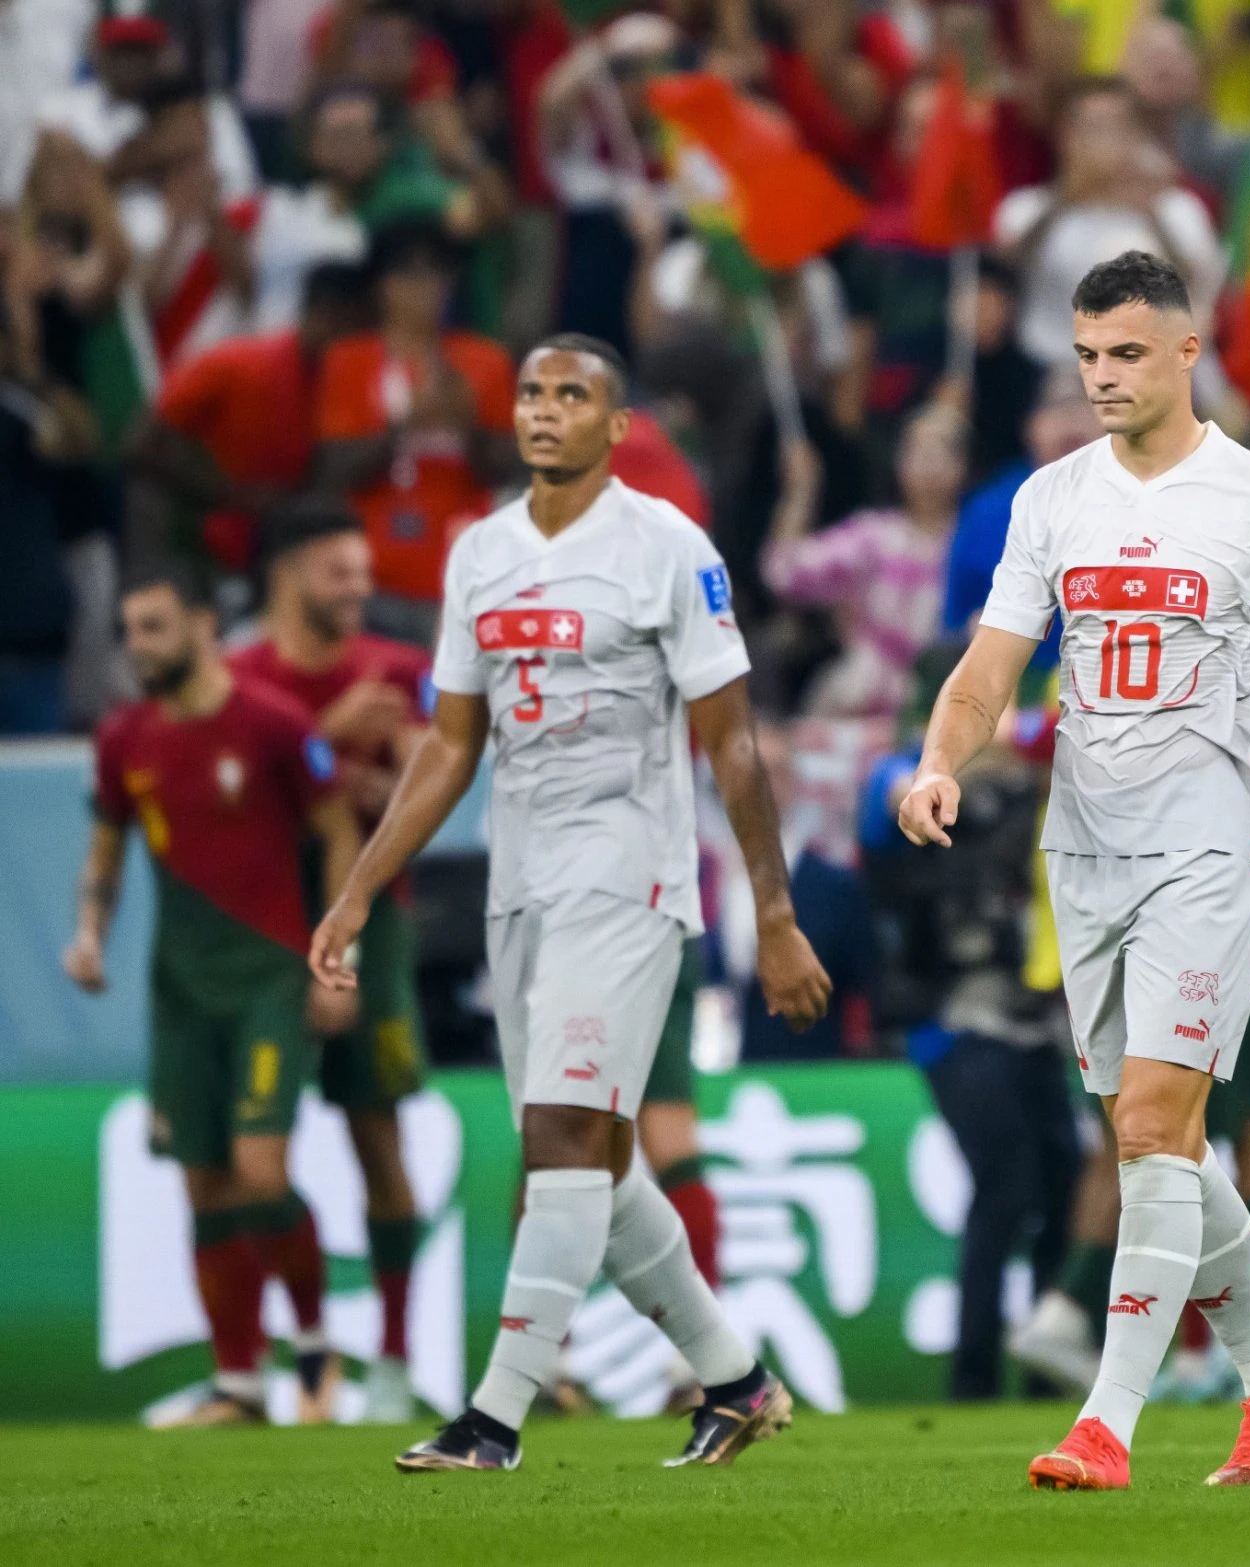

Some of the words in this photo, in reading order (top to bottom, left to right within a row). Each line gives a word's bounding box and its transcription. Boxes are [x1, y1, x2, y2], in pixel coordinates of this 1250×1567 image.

[1119, 546, 1152, 558] PUMA
[1099, 619, 1162, 701] 10
[512, 655, 548, 723] 5
[1174, 1024, 1206, 1043] PUMA
